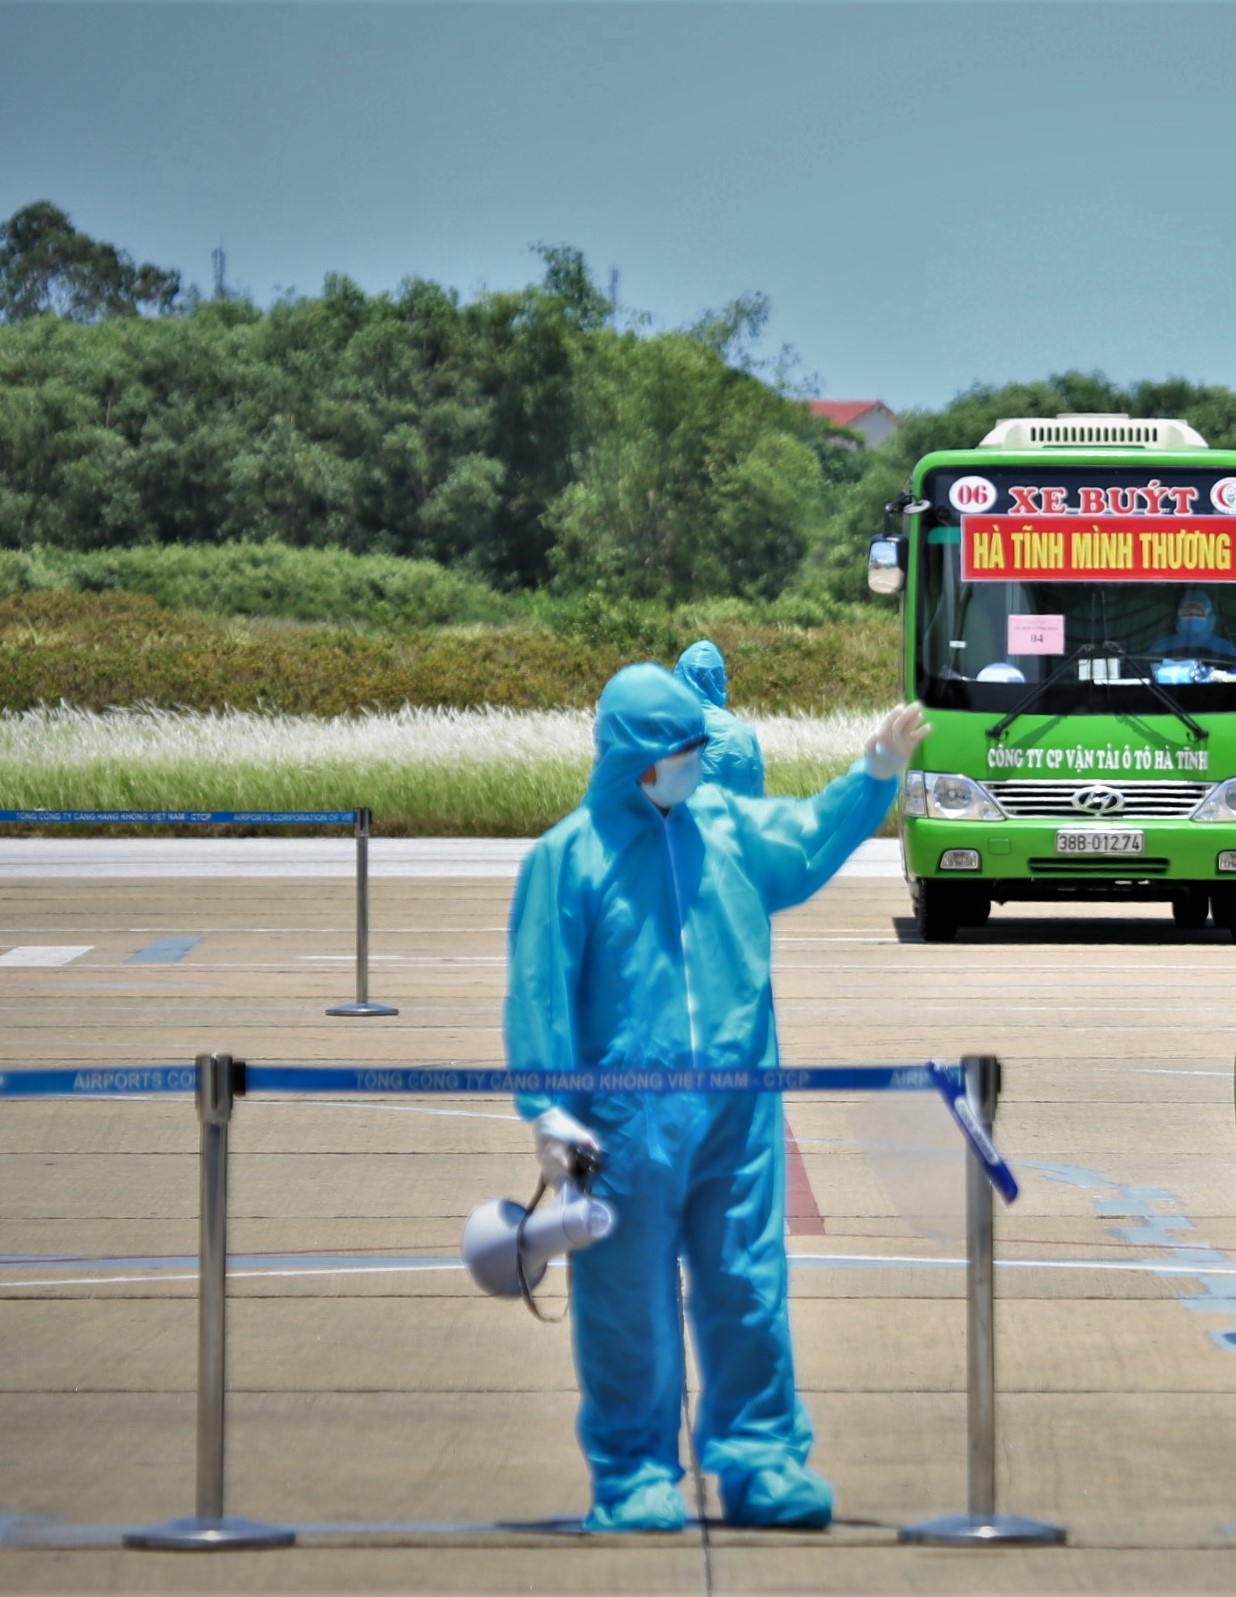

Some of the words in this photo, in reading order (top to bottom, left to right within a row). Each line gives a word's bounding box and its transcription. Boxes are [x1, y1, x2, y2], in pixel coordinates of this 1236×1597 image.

[957, 485, 988, 505] 06
[1008, 486, 1067, 516] XE
[1078, 479, 1198, 516] BUÝT
[973, 525, 1005, 569] HÀ
[1011, 526, 1064, 569] TĨNH
[1071, 525, 1133, 569] MÌNH
[1139, 529, 1231, 570] THƯƠNG
[1031, 633, 1044, 643] 04
[987, 744, 1024, 768] CÔNG
[1026, 748, 1044, 768] TY
[1046, 748, 1063, 768] CP
[1065, 745, 1094, 772] VẬN
[1096, 743, 1119, 769] TẢI
[1122, 745, 1132, 769] Ô
[1134, 745, 1151, 769] TÔ
[1154, 745, 1174, 770] HÀ
[1176, 747, 1209, 770] TĨNH
[168, 812, 185, 821] NAM
[341, 813, 355, 822] VIE
[1059, 835, 1140, 851] 38B-012.74
[72, 1071, 162, 1090] AIRPORTS
[168, 1071, 196, 1088] CO
[465, 1072, 486, 1089] TY
[710, 1071, 748, 1089] NAM
[763, 1070, 812, 1089] CTCP
[890, 1070, 930, 1088] AIRP
